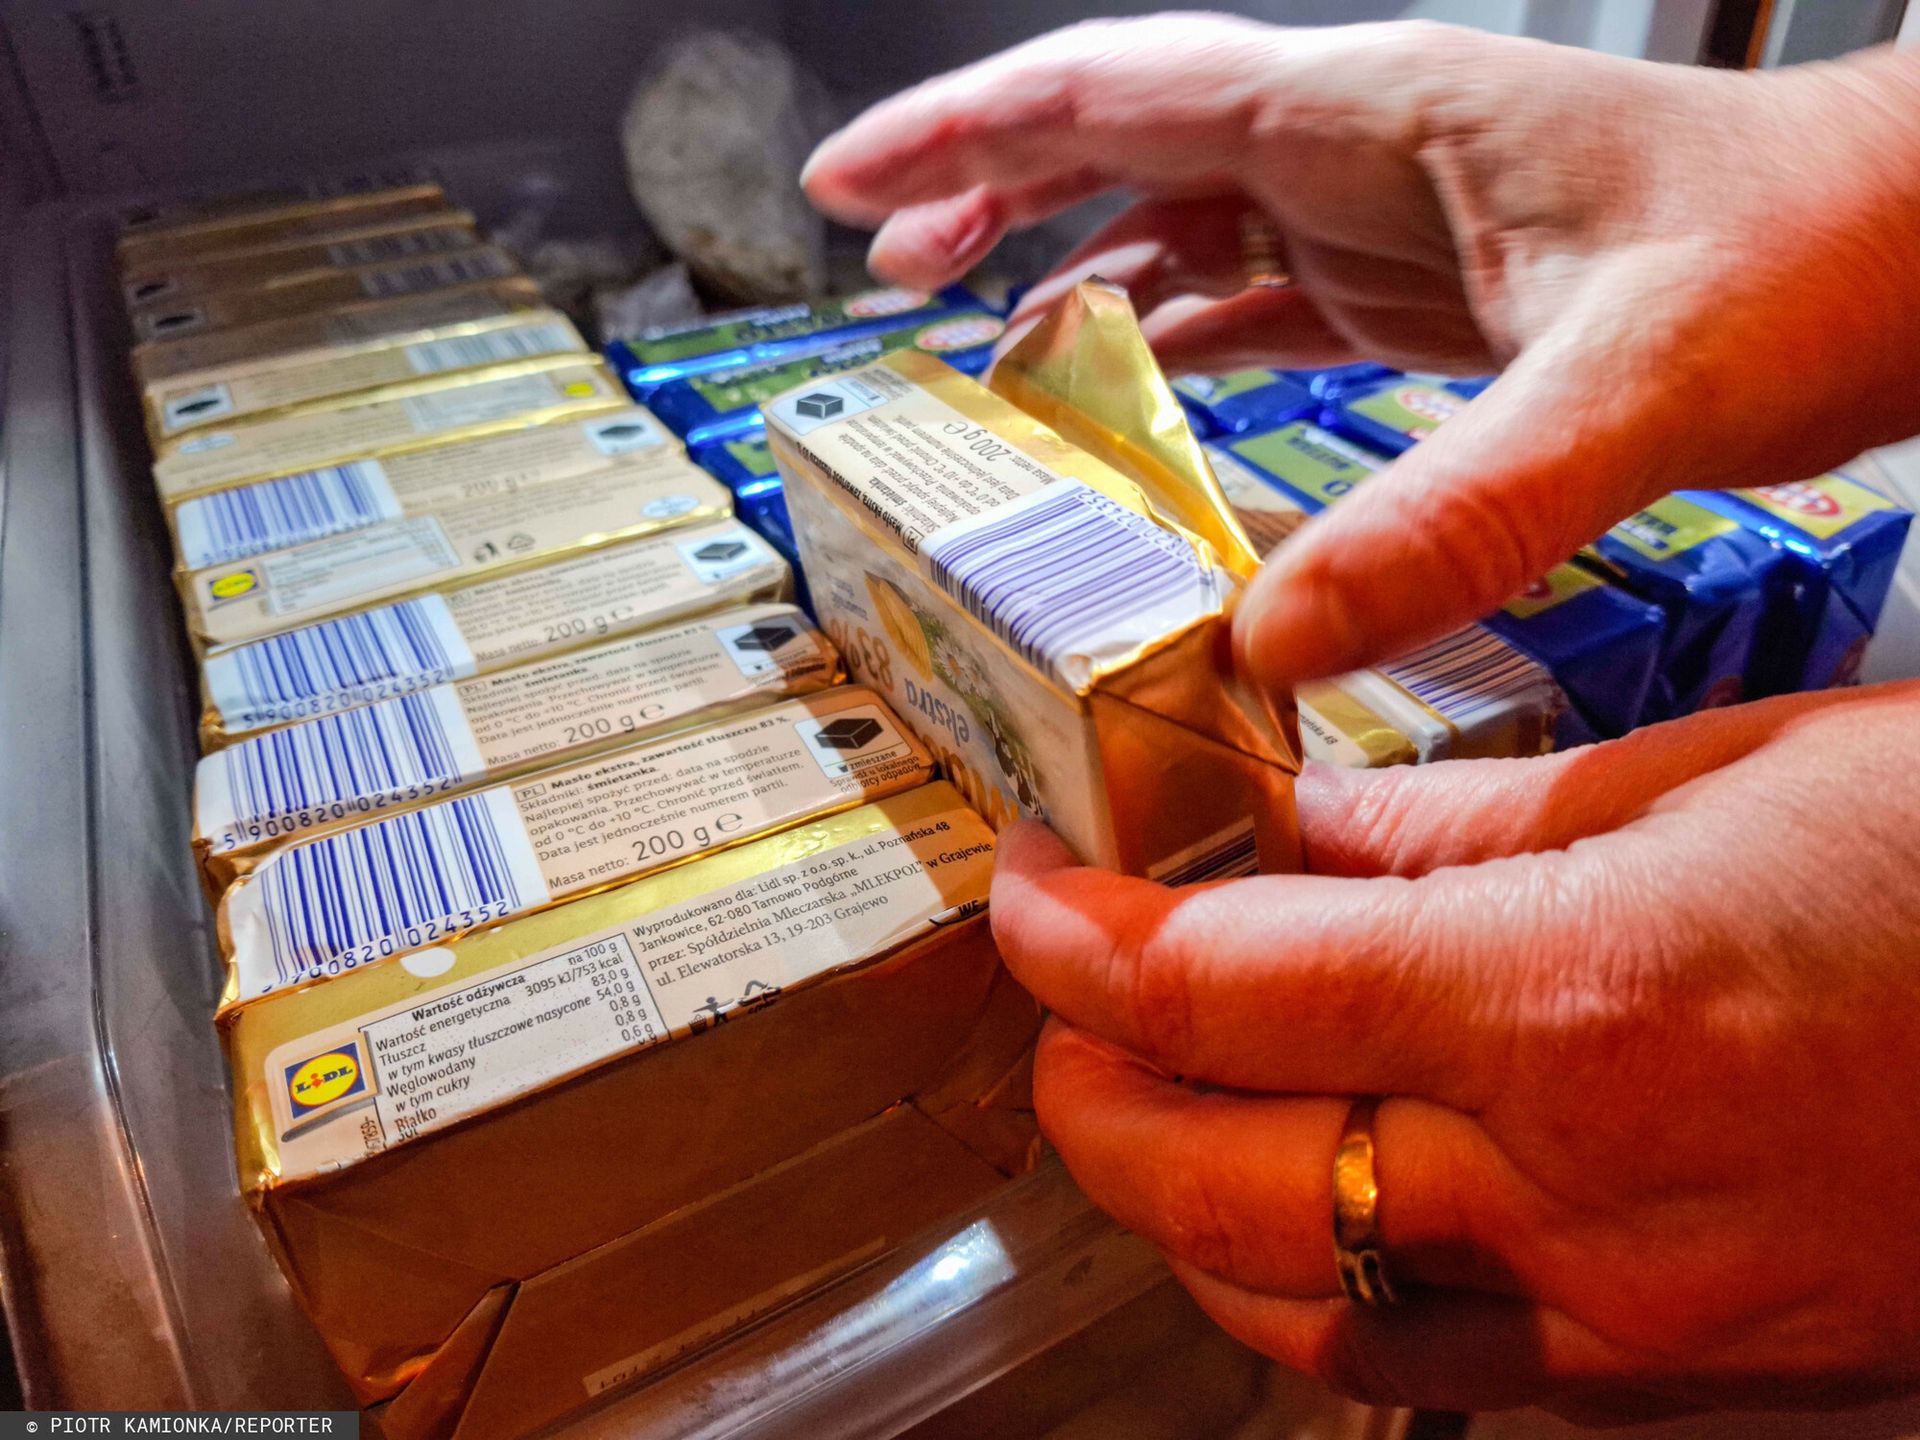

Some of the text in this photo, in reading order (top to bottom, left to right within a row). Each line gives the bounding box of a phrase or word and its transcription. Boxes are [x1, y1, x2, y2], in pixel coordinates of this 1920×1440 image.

[963, 428, 988, 440] g
[969, 438, 1011, 461] 200
[543, 615, 609, 643] 200 g
[487, 753, 521, 766] Masa
[563, 718, 611, 743] 200
[619, 714, 637, 734] g
[904, 677, 970, 748] ekstra
[521, 786, 542, 799] PL
[551, 771, 592, 790] Masło
[594, 756, 641, 776] ekstra,
[641, 739, 705, 763] zawartość
[706, 724, 758, 744] tłuszczu
[759, 719, 775, 730] 83
[524, 744, 770, 824] Najlepiej spożyć przed: data na spodzie
[529, 748, 802, 837] opakowania. Przechowywać w temperaturze
[849, 750, 898, 770] zmieszane
[224, 775, 452, 849] 5 900820 024352
[519, 786, 583, 813] Składniki:
[534, 836, 553, 849] od
[588, 818, 606, 832] do
[609, 810, 632, 824] +10
[656, 786, 707, 810] Chronić
[708, 777, 745, 797] przed
[745, 760, 806, 783] światłem.
[538, 778, 790, 862] Data jest jednocześnie numerem partii.
[548, 870, 587, 890] Masa
[587, 857, 631, 877] netto:
[631, 829, 685, 862] 200
[693, 825, 711, 847] g
[633, 820, 952, 938] Wyprodukowano dla: Lidl sp. z o.o. sp. k., ul. Poznańska 48
[406, 900, 511, 947] 024352
[638, 867, 860, 953] Jankowice, 62-080 Tarnowo Podgórne
[648, 949, 688, 972] przez:
[687, 916, 772, 955] Spółdzielnia
[771, 889, 848, 924] Mleczarska
[925, 858, 940, 870] w
[939, 841, 994, 866] Grajewie
[656, 893, 890, 988] ul. Elewatorska 13, 19-203 Grajewo
[567, 941, 618, 966] na 100 g
[375, 1025, 427, 1052] Wartość
[429, 995, 513, 1034] energetyczna
[524, 976, 558, 998] 3095
[598, 953, 625, 969] kcal
[378, 967, 630, 1067] Tłuszcz 83,0 g
[387, 980, 636, 1081] w tym kwasy tłuszczowe nasycone 54,0 g
[411, 973, 527, 1022] Wartość odżywcza
[385, 993, 642, 1099] Węglowodany 0,8 g
[393, 1106, 438, 1135] Białko
[621, 1025, 642, 1042] 0,6
[644, 1023, 655, 1035] g
[394, 1008, 648, 1114] w tym cukry 0,8 g
